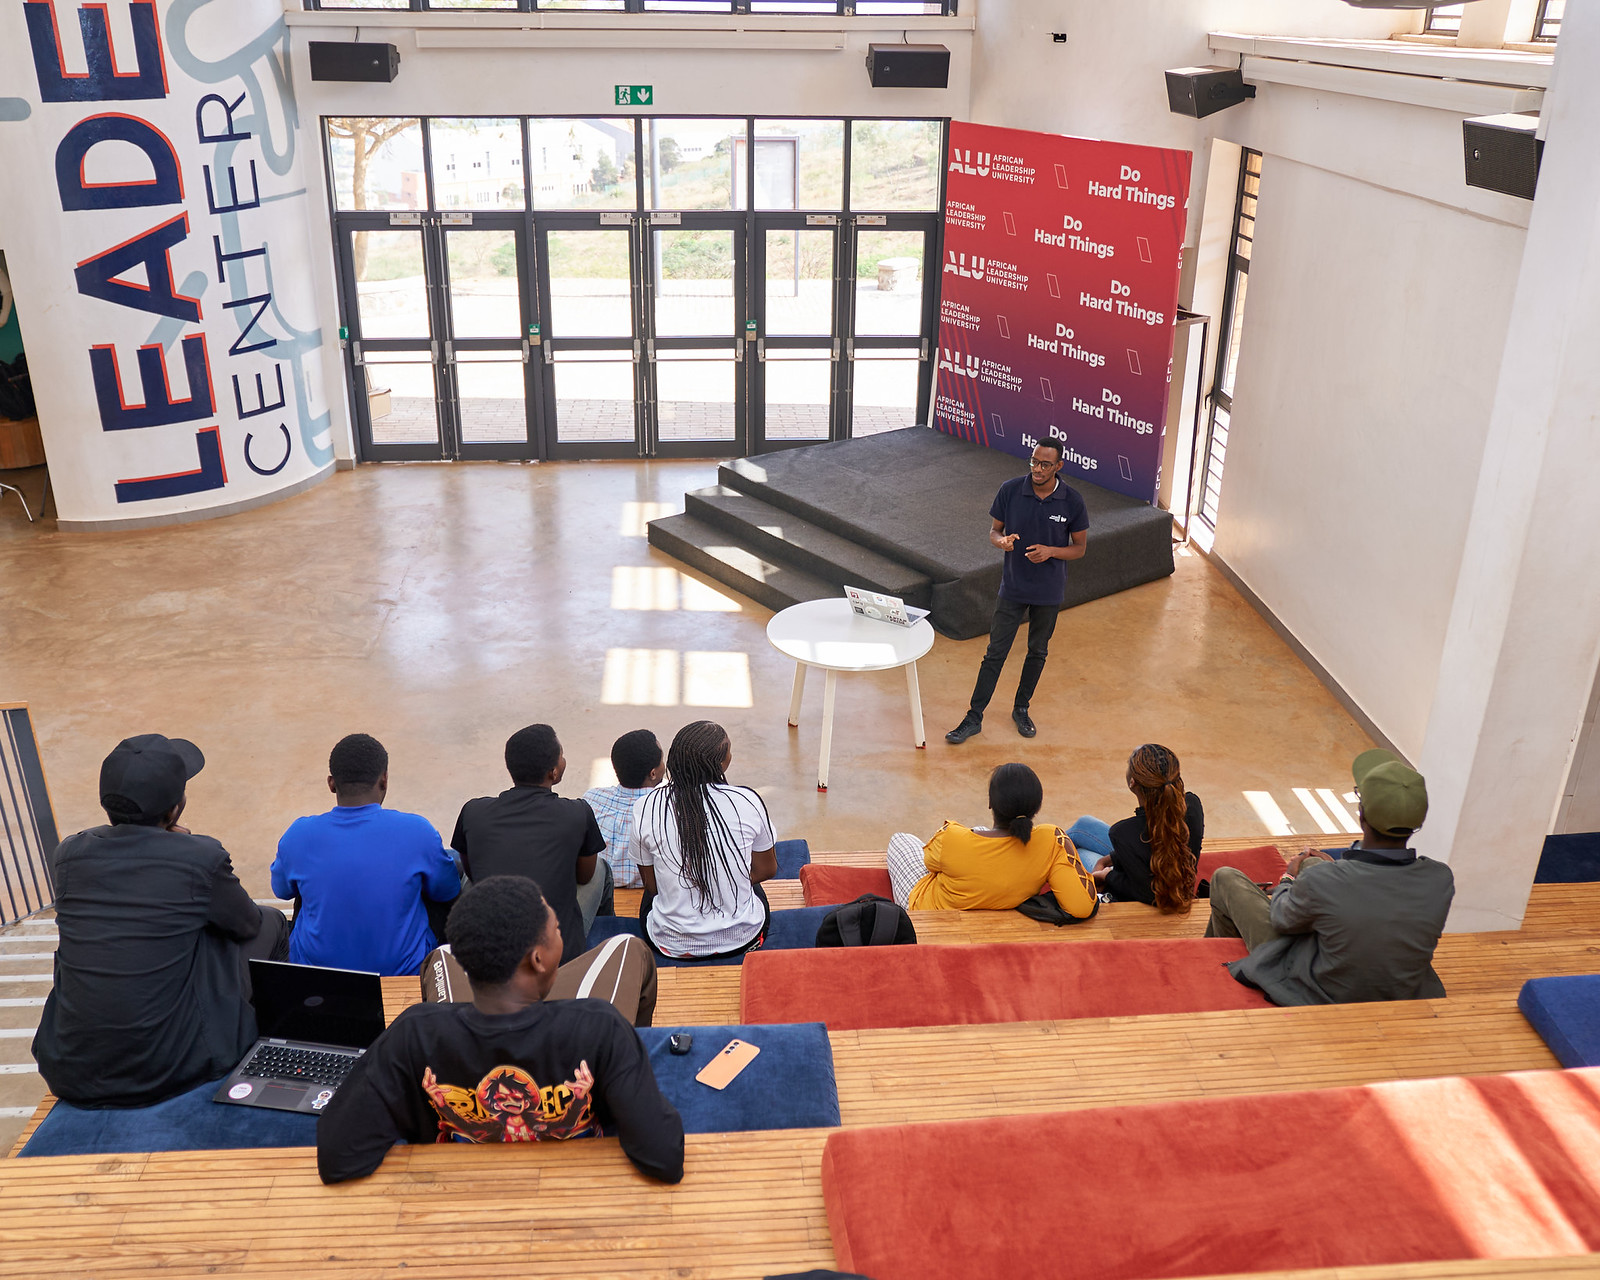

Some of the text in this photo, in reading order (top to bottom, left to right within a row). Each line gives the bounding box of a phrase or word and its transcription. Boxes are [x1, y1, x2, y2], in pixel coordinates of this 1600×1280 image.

[949, 148, 991, 177] ALU
[993, 154, 1024, 165] AFRICAN
[992, 162, 1036, 176] LEADERSHIP
[1120, 165, 1141, 182] Do
[991, 171, 1035, 185] UNIVERSITY
[1088, 180, 1122, 199] Hard
[1125, 186, 1175, 210] Things
[947, 200, 975, 212] AFRICAN
[945, 216, 986, 231] UNIVERSITY
[946, 209, 986, 222] LEADERSHIP
[1063, 215, 1083, 232] Do
[1034, 228, 1115, 259] Hard Things
[943, 250, 985, 280] ALU
[987, 259, 1017, 272] AFRICAN
[196, 91, 292, 476] CENTER
[986, 267, 1029, 283] LEADERSHIP
[986, 276, 1029, 292] UNIVERSITY
[1110, 279, 1131, 297] Do
[942, 300, 970, 313] AFRICAN
[1079, 292, 1112, 313] Hard
[1116, 300, 1164, 326] Things
[940, 315, 980, 331] UNIVERSITY
[941, 308, 981, 324] LEADERSHIP
[1055, 322, 1075, 340] Do
[1027, 333, 1106, 368] Hard Things
[939, 348, 980, 379] ALU
[982, 359, 1012, 373] AFRICAN
[980, 375, 1022, 393] UNIVERSITY
[981, 367, 1023, 385] LEADERSHIP
[937, 395, 965, 409] AFRICAN
[1101, 388, 1122, 406] Do
[936, 402, 976, 420] LEADERSHIP
[936, 409, 975, 428] UNIVERSITY
[1072, 397, 1104, 419] Hard
[1107, 407, 1154, 435] Things
[1049, 425, 1068, 442] Do
[1022, 433, 1098, 471] Ha hings
